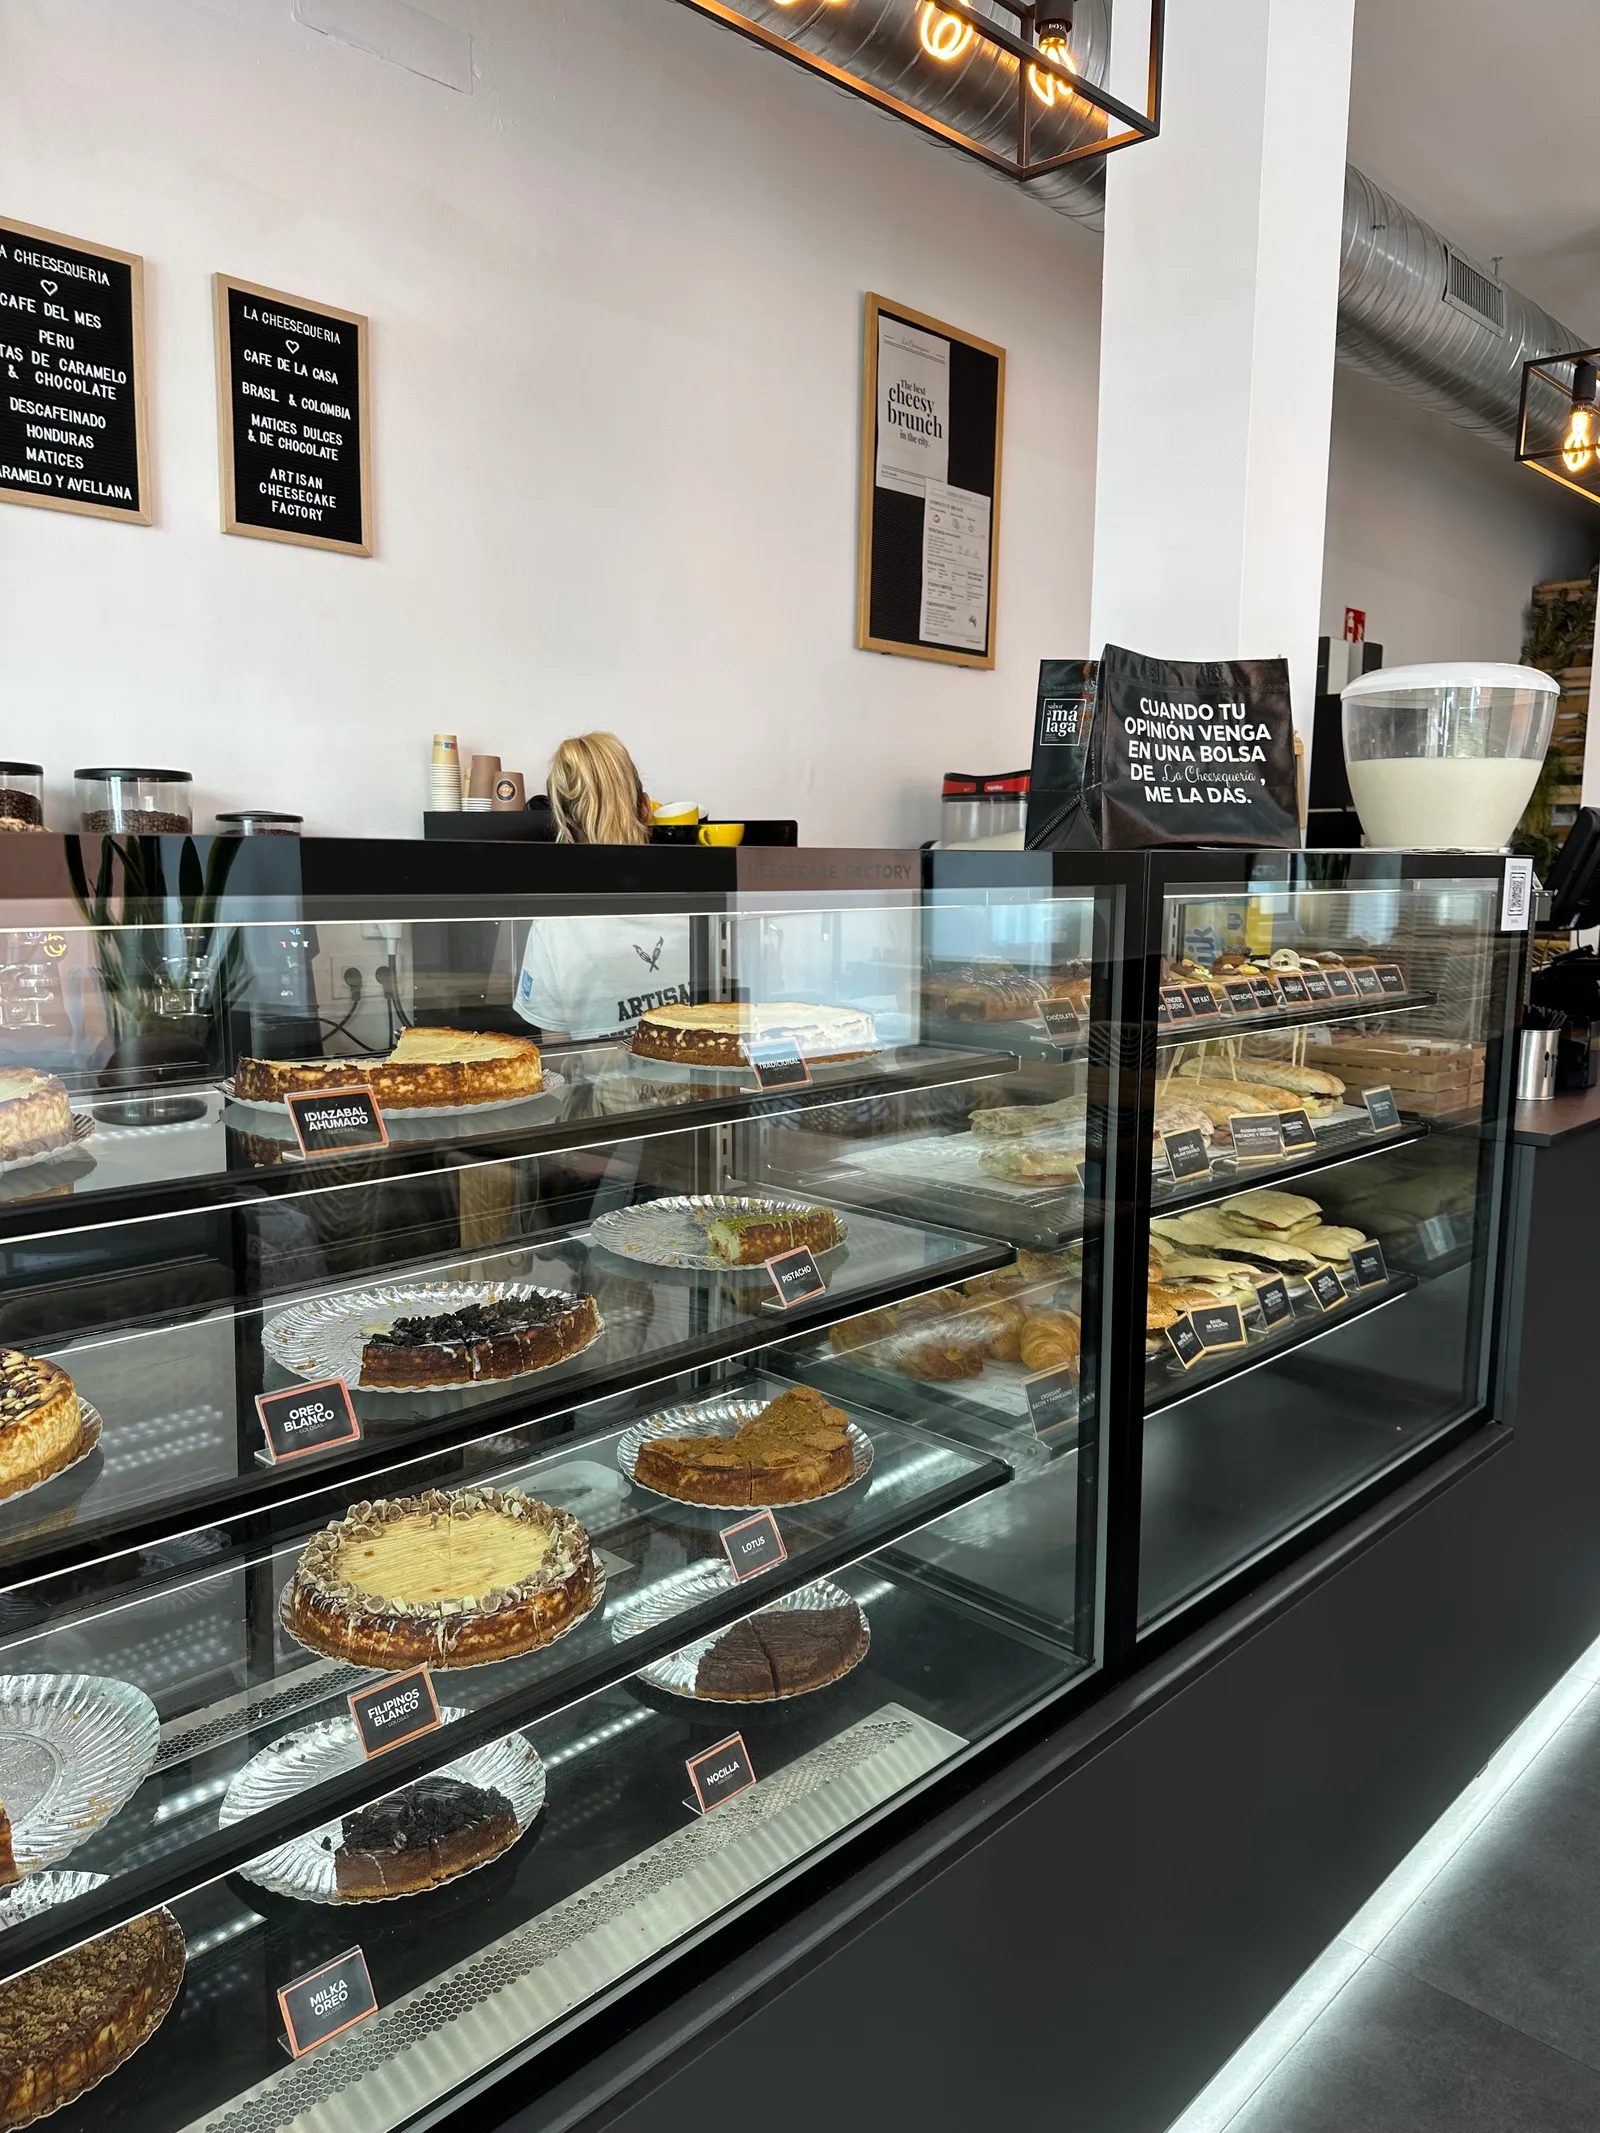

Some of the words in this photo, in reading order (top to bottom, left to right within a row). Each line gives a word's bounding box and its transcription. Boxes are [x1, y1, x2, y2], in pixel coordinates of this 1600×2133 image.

[14, 249, 110, 286] CHEESEQUERIA
[0, 292, 36, 313] CAFE
[43, 302, 70, 321] DEL
[74, 310, 102, 329] MES
[243, 305, 259, 322] LA
[261, 312, 341, 345] CHEESEQUERIA
[39, 329, 75, 350] PERU
[31, 350, 51, 368] DE
[59, 358, 127, 384] CARAMELO
[243, 349, 273, 368] CAFE
[277, 357, 291, 372] DE
[294, 362, 308, 377] LA
[312, 367, 339, 385] CASA
[8, 364, 19, 380] &
[35, 371, 117, 400] CHOCOLATE
[900, 379, 913, 391] The
[913, 383, 926, 396] best
[9, 396, 106, 429] DESCAFEINADO
[242, 381, 280, 402] BRASIL
[288, 393, 297, 407] &
[301, 397, 351, 420] COLOMBIA
[889, 383, 935, 418] cheesy
[251, 413, 298, 435] MATICES
[303, 425, 343, 446] DULCES
[887, 400, 943, 439] brunch
[26, 423, 94, 449] HONDURAS
[247, 429, 257, 443] &
[260, 431, 275, 447] DE
[278, 437, 339, 461] CHOCOLATE
[900, 430, 906, 440] in
[907, 432, 917, 443] the
[918, 436, 931, 448] city.
[26, 446, 84, 470] MATICES
[55, 474, 64, 488] Y
[67, 477, 133, 500] AVELLANA
[270, 467, 323, 490] ARTISAN
[259, 481, 337, 509] CHEESECAKE
[271, 500, 323, 522] FACTORY
[1052, 705, 1078, 721] má
[1140, 697, 1214, 720] CUANDO
[1218, 703, 1246, 720] TU
[1046, 717, 1076, 737] laga
[1124, 716, 1195, 741] OPINIÓN
[1198, 723, 1272, 741] VENGA
[1128, 740, 1151, 760] EN
[1154, 744, 1196, 762] UNA
[1200, 745, 1267, 763] BOLSA
[1130, 763, 1156, 781] DE
[1162, 763, 1183, 783] La
[1144, 786, 1174, 803] ME
[1177, 787, 1204, 803] LA
[1206, 787, 1252, 804] DAS.
[844, 865, 912, 880] FACTORY
[1231, 993, 1253, 1001] PISTACHO
[1284, 985, 1303, 993] MANGO
[617, 982, 692, 1022] ARTISA
[1046, 1012, 1075, 1021] CHOCOLATE
[760, 1058, 800, 1070] TRADICIONAL
[304, 1106, 367, 1122] IDIAZABAL
[309, 1116, 369, 1132] AHUMADO
[781, 1265, 811, 1283] PISTACHO
[283, 1410, 334, 1432] BLANCO
[289, 1402, 324, 1420] OREO
[742, 1536, 765, 1553] LOTUS
[368, 1688, 420, 1719] FILIPINOS
[374, 1700, 418, 1727] BLANCO
[706, 1761, 740, 1786] NOCILLA
[310, 1979, 347, 2007] MILKA
[315, 1990, 348, 2015] OREO
